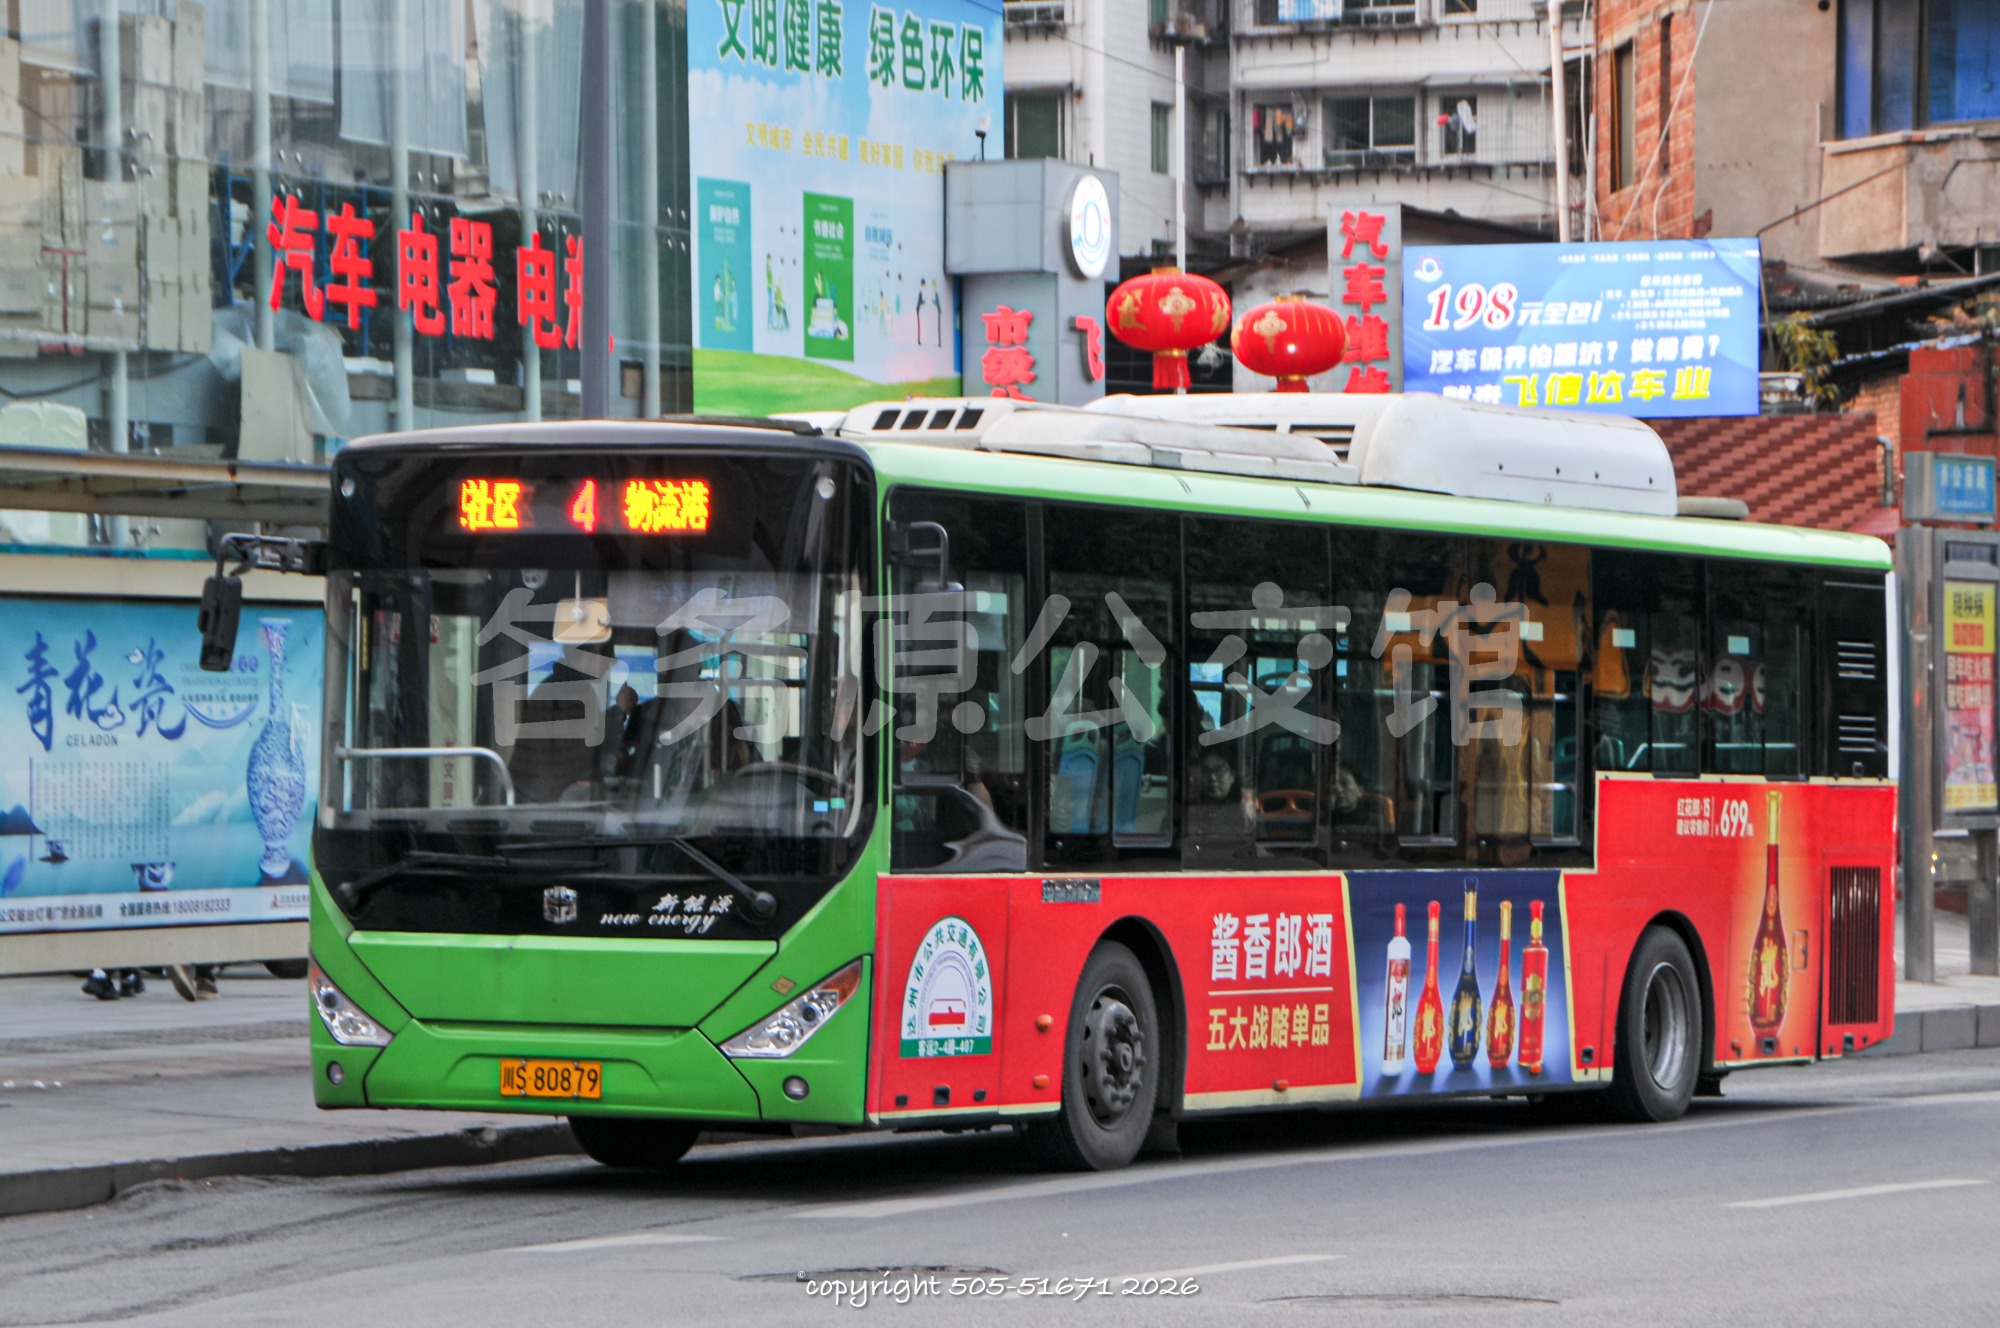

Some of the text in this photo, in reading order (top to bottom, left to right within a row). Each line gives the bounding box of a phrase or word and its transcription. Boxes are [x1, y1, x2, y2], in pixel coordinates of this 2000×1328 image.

[718, 0, 985, 104] 文明健康 绿色环保
[745, 121, 792, 152] 文明城市
[803, 131, 849, 161] 全民共建
[858, 138, 904, 169] 美好家园
[266, 194, 378, 331] 汽车
[397, 213, 498, 341] 电器
[572, 479, 596, 532] 4
[624, 479, 710, 532] 物流港
[16, 629, 187, 752] 青花瓷
[66, 734, 119, 748] CELADON
[600, 912, 719, 935] new energy
[652, 893, 734, 914] 新能源
[1211, 912, 1333, 981] 酱香郎酒
[907, 922, 987, 1037] 达州市公共交通有限公司
[1206, 1003, 1330, 1051] 五大战略单品
